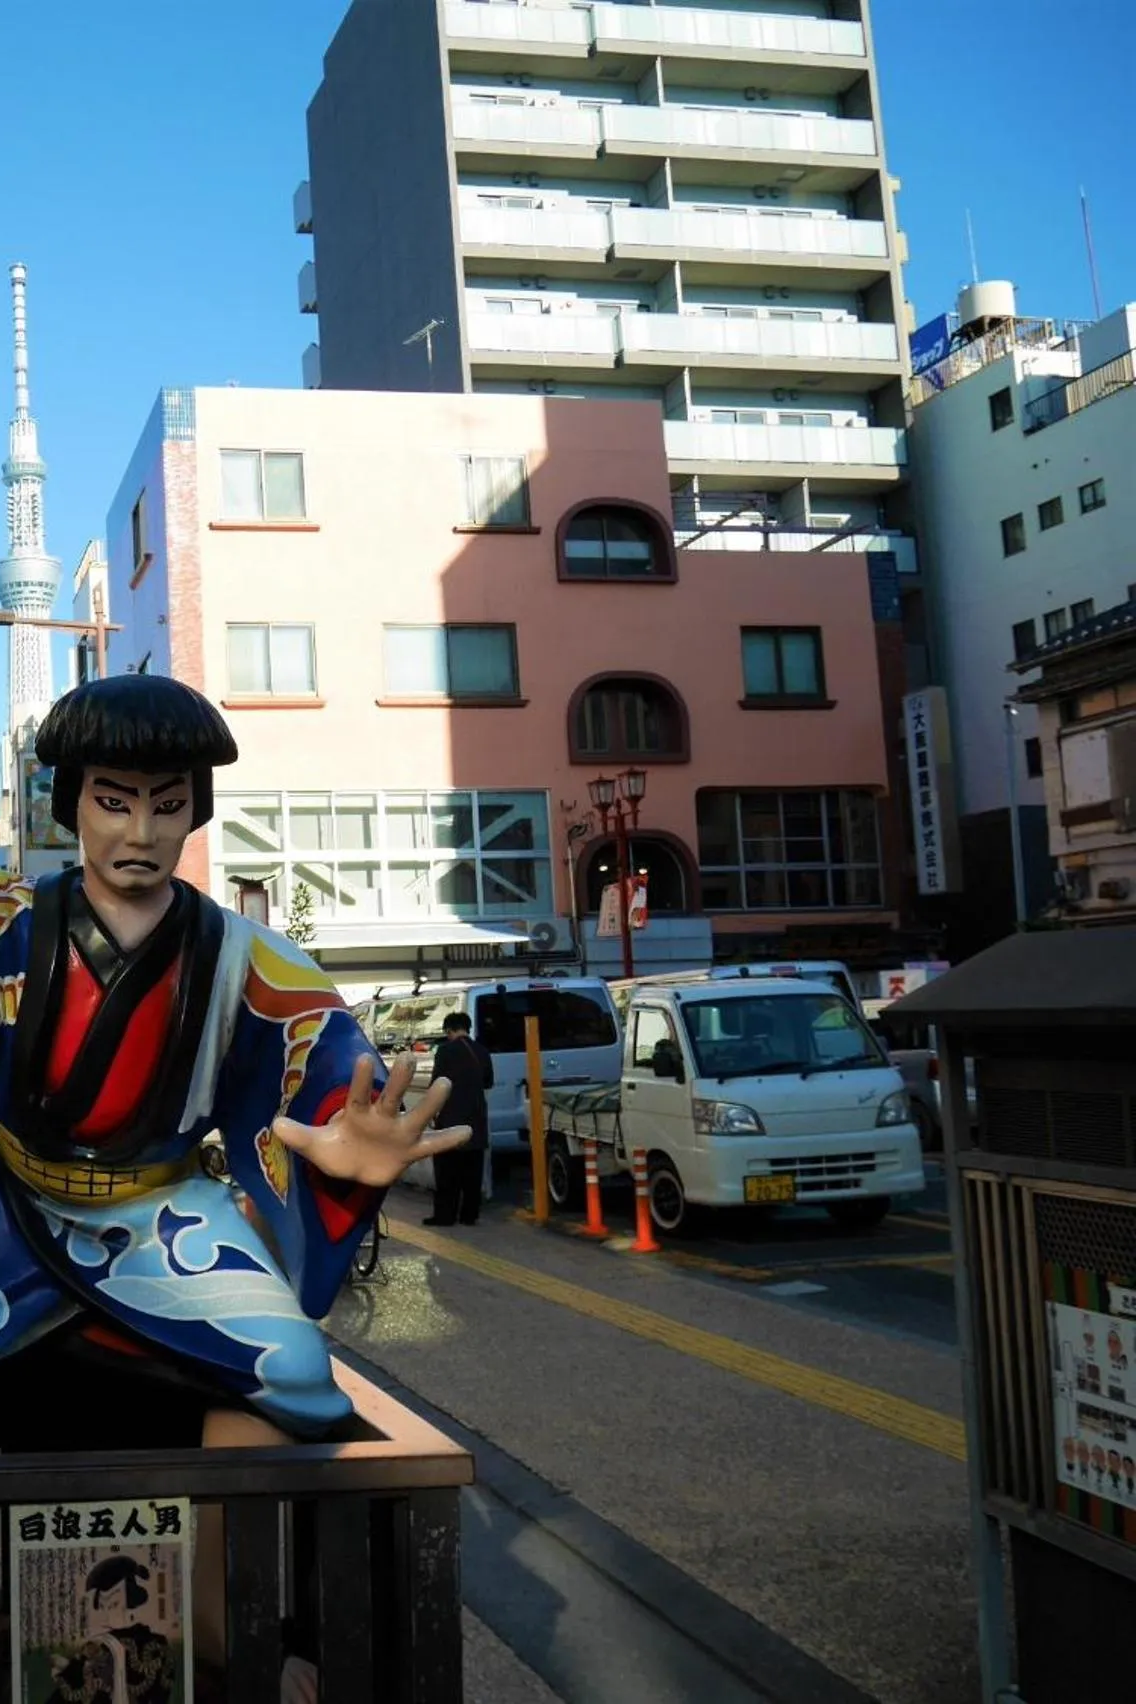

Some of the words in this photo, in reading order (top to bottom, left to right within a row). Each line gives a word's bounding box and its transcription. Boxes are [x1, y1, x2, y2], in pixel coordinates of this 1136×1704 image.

[19, 1504, 182, 1542] 白浪五人男
